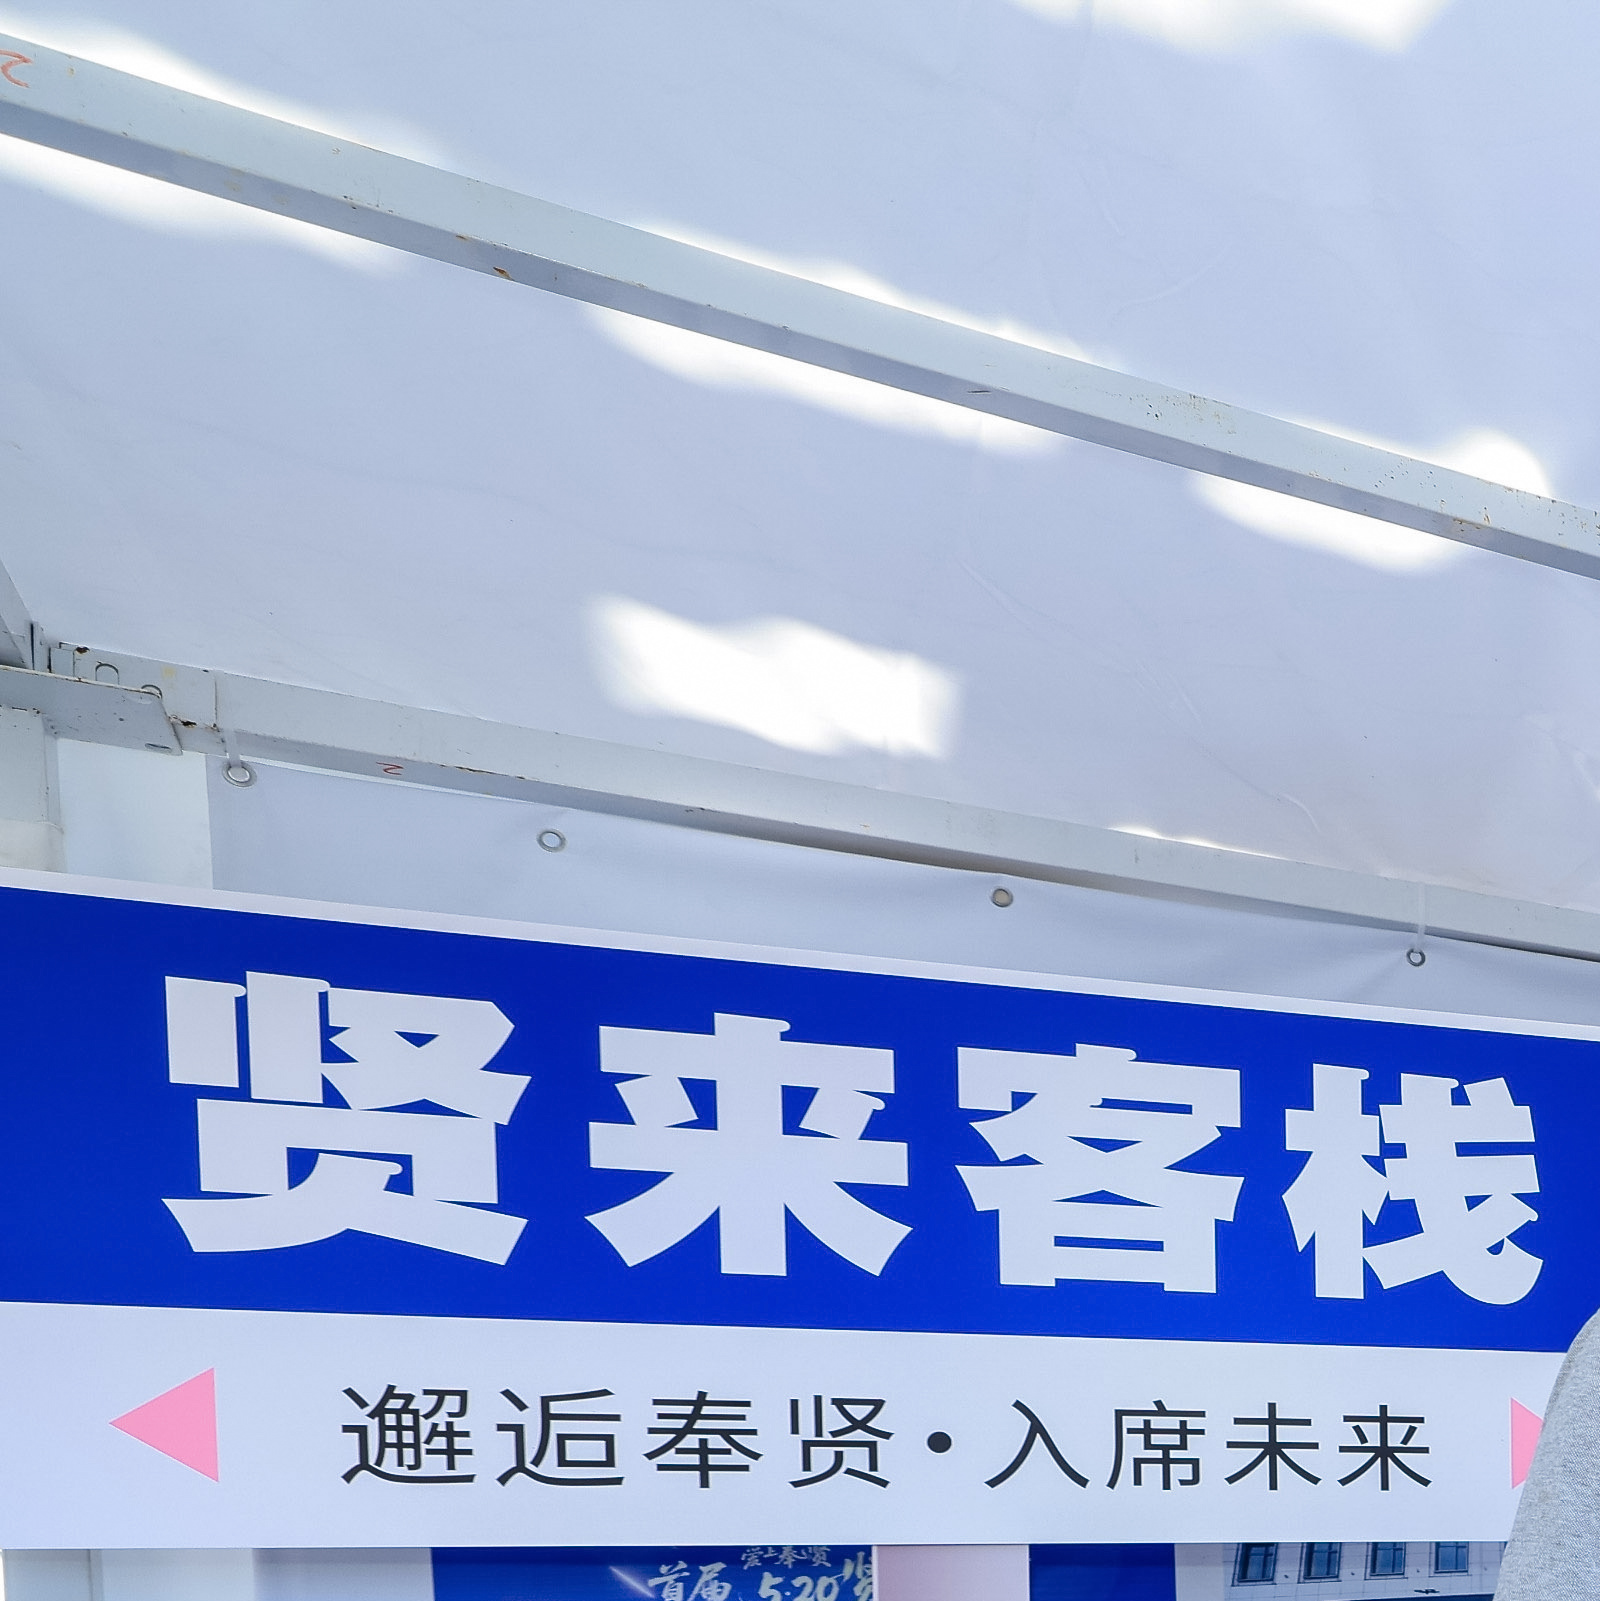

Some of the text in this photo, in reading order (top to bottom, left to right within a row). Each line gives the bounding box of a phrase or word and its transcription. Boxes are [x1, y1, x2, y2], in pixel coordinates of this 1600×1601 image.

[161, 970, 1544, 1306] 贤来客栈
[341, 1385, 1433, 1492] 邂逅奉贤·入席未来
